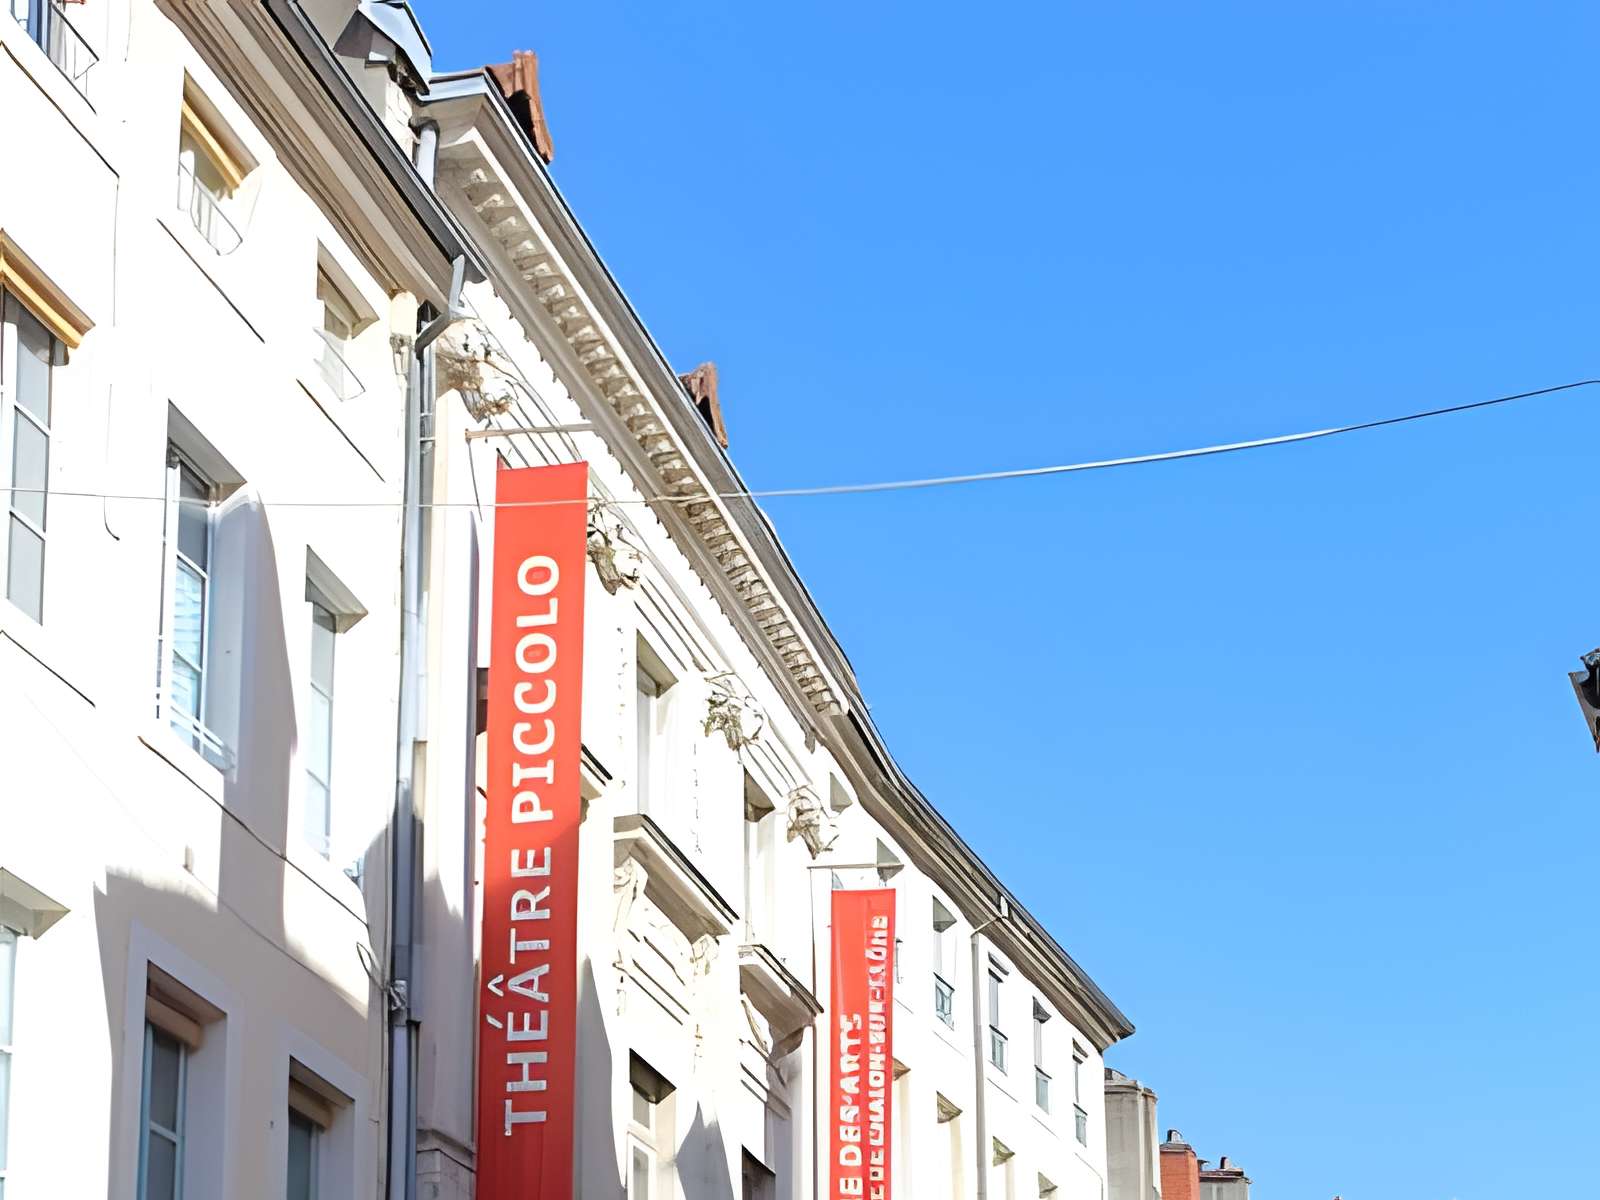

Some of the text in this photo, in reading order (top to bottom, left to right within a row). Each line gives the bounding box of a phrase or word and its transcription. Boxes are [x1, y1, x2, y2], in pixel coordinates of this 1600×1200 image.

[485, 554, 560, 1137] THÉÂTRE PICCOLO
[839, 1104, 863, 1167] DES
